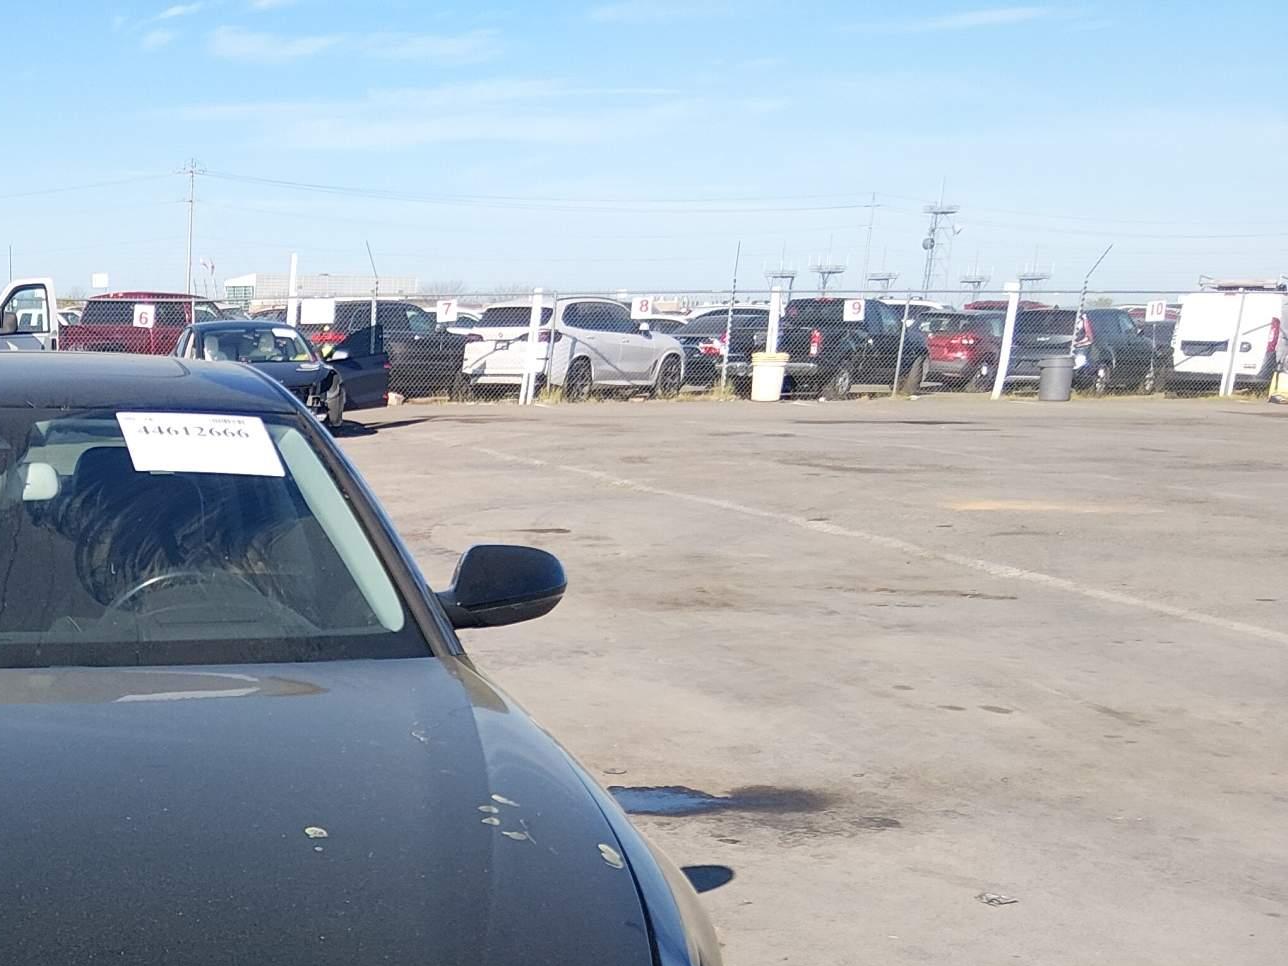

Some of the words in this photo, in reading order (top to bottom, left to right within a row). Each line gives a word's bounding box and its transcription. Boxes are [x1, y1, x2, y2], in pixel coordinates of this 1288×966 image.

[442, 302, 452, 316] 7
[639, 299, 649, 313] 8
[852, 301, 862, 315] 9
[1151, 302, 1163, 316] 10
[139, 311, 149, 325] 6
[138, 425, 249, 438] 44612666
